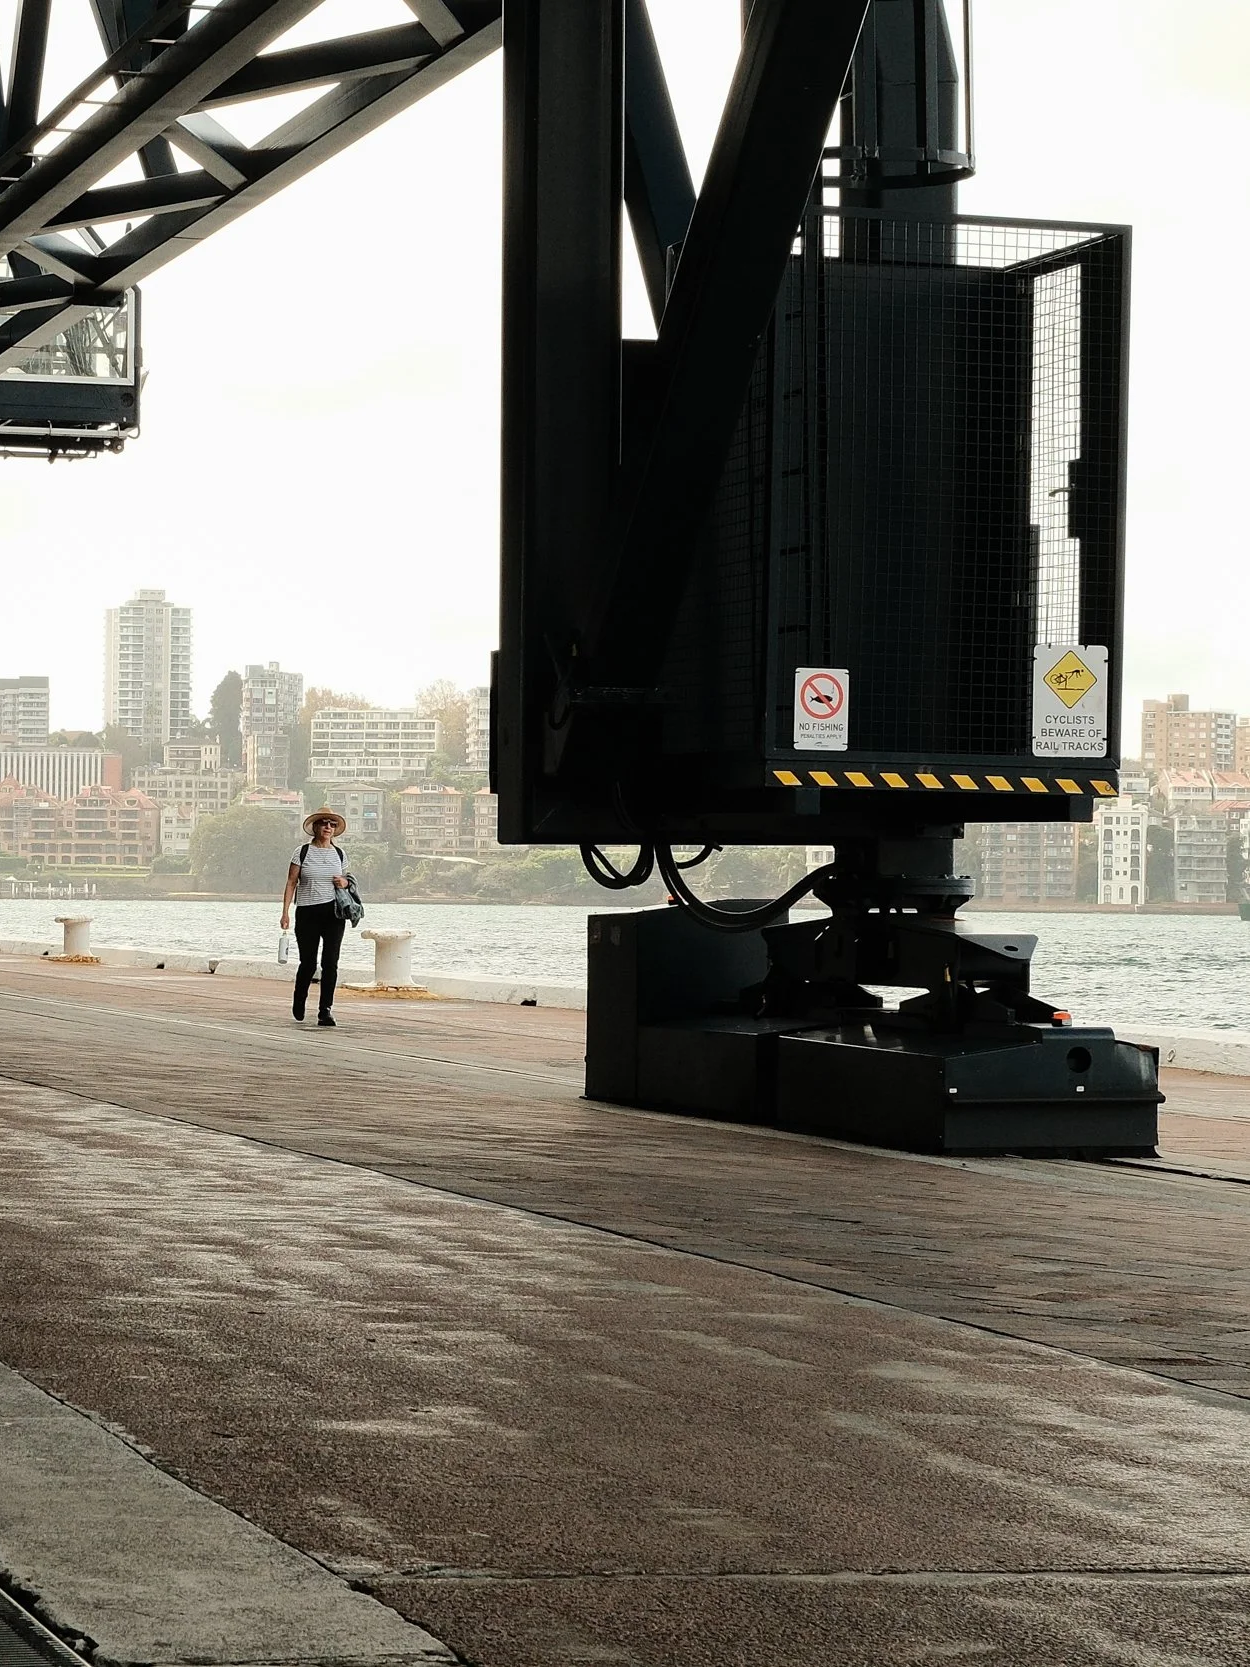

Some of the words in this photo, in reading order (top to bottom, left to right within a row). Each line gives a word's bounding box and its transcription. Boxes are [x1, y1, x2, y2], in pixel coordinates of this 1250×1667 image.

[1045, 715, 1095, 725] CYCLISTS
[799, 723, 810, 731] NO
[812, 723, 844, 731] FISHING
[1041, 728, 1085, 738] BEWARE
[1088, 729, 1102, 738] OF
[1036, 741, 1059, 750] RAIL
[1062, 742, 1104, 751] TRACKS
